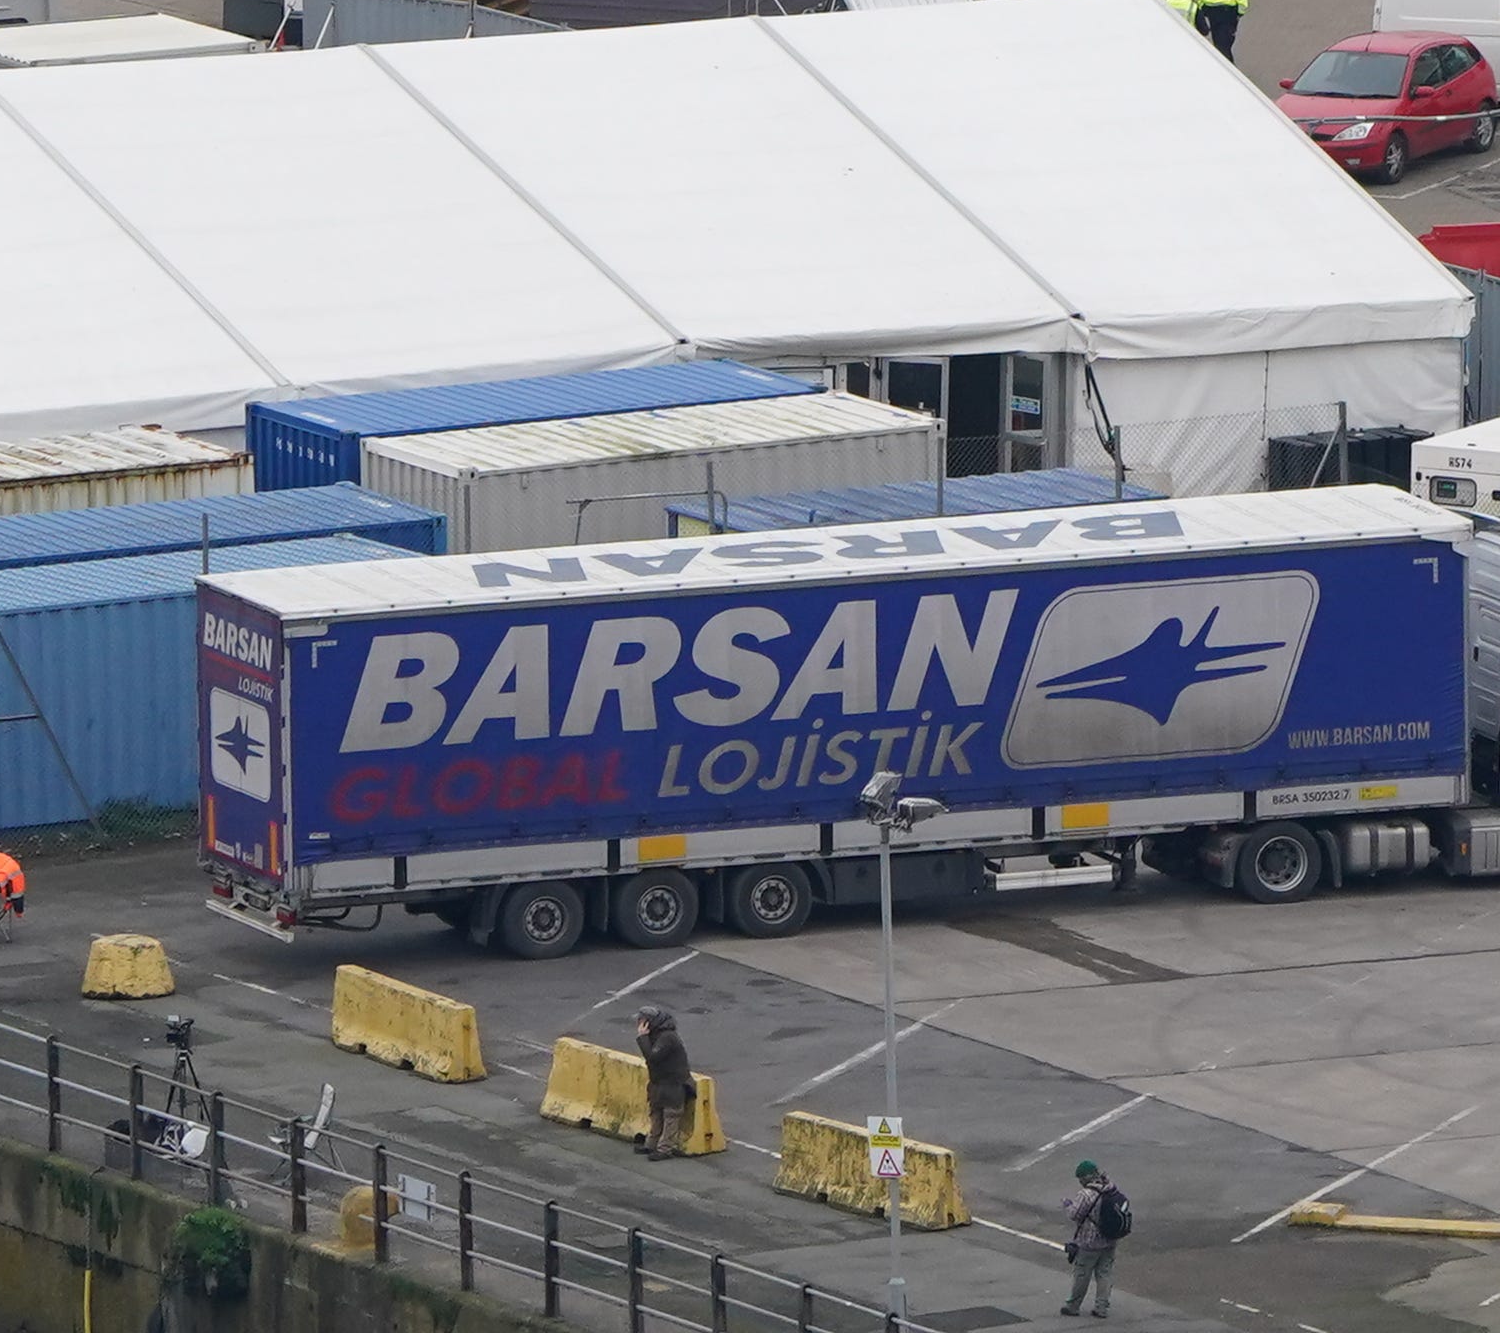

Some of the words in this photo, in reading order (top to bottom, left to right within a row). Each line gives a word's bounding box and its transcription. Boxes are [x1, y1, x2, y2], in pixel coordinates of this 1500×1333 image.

[472, 511, 1184, 587] BARSAN
[202, 611, 273, 671] BARSAN
[339, 589, 1020, 754] BARSAN
[329, 747, 633, 822] GLOBAL
[657, 709, 984, 799] LOJİSTİK
[1287, 720, 1431, 750] WWW.BARSAN.COM
[1272, 793, 1298, 805] BRSA
[1302, 789, 1341, 802] 350232
